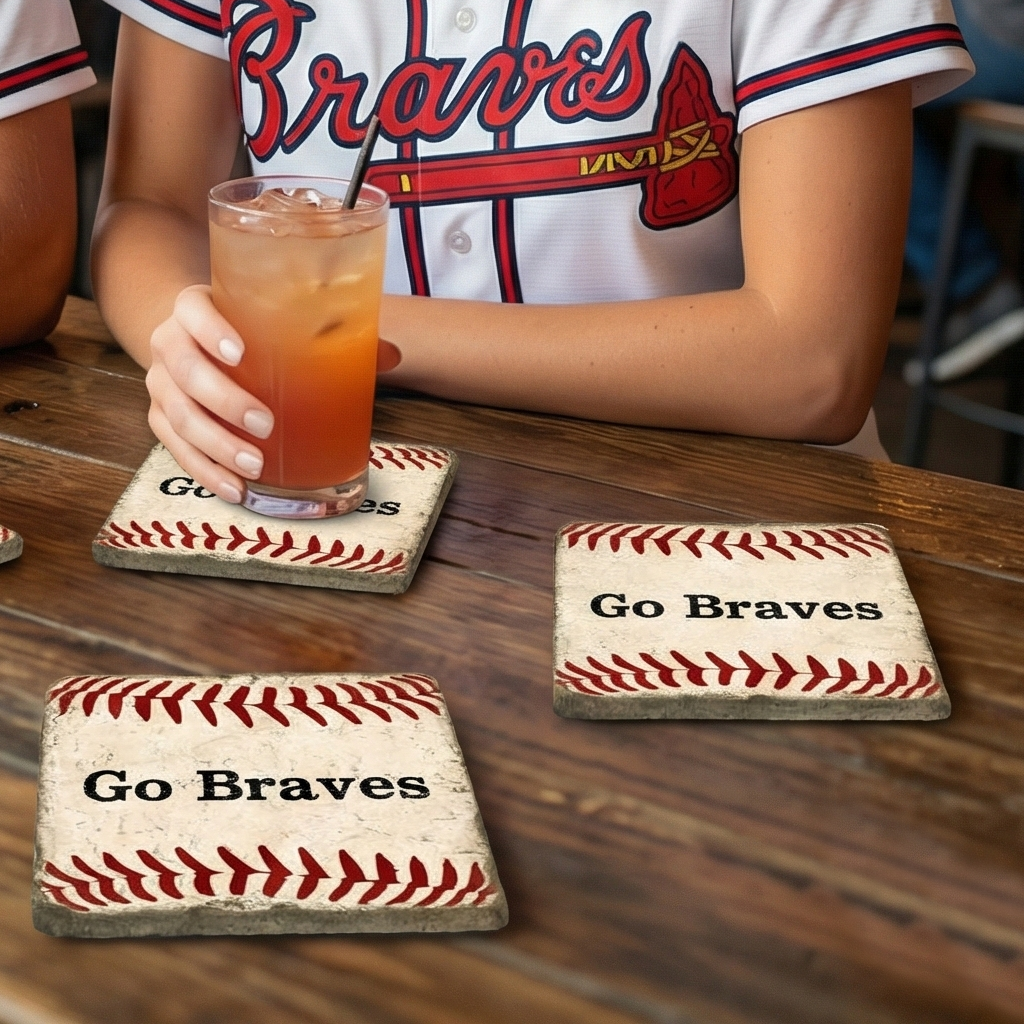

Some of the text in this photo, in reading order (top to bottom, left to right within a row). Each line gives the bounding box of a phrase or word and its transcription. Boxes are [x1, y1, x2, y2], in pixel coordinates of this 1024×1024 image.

[590, 593, 884, 621] Go Braves
[83, 770, 430, 802] Go Braves
